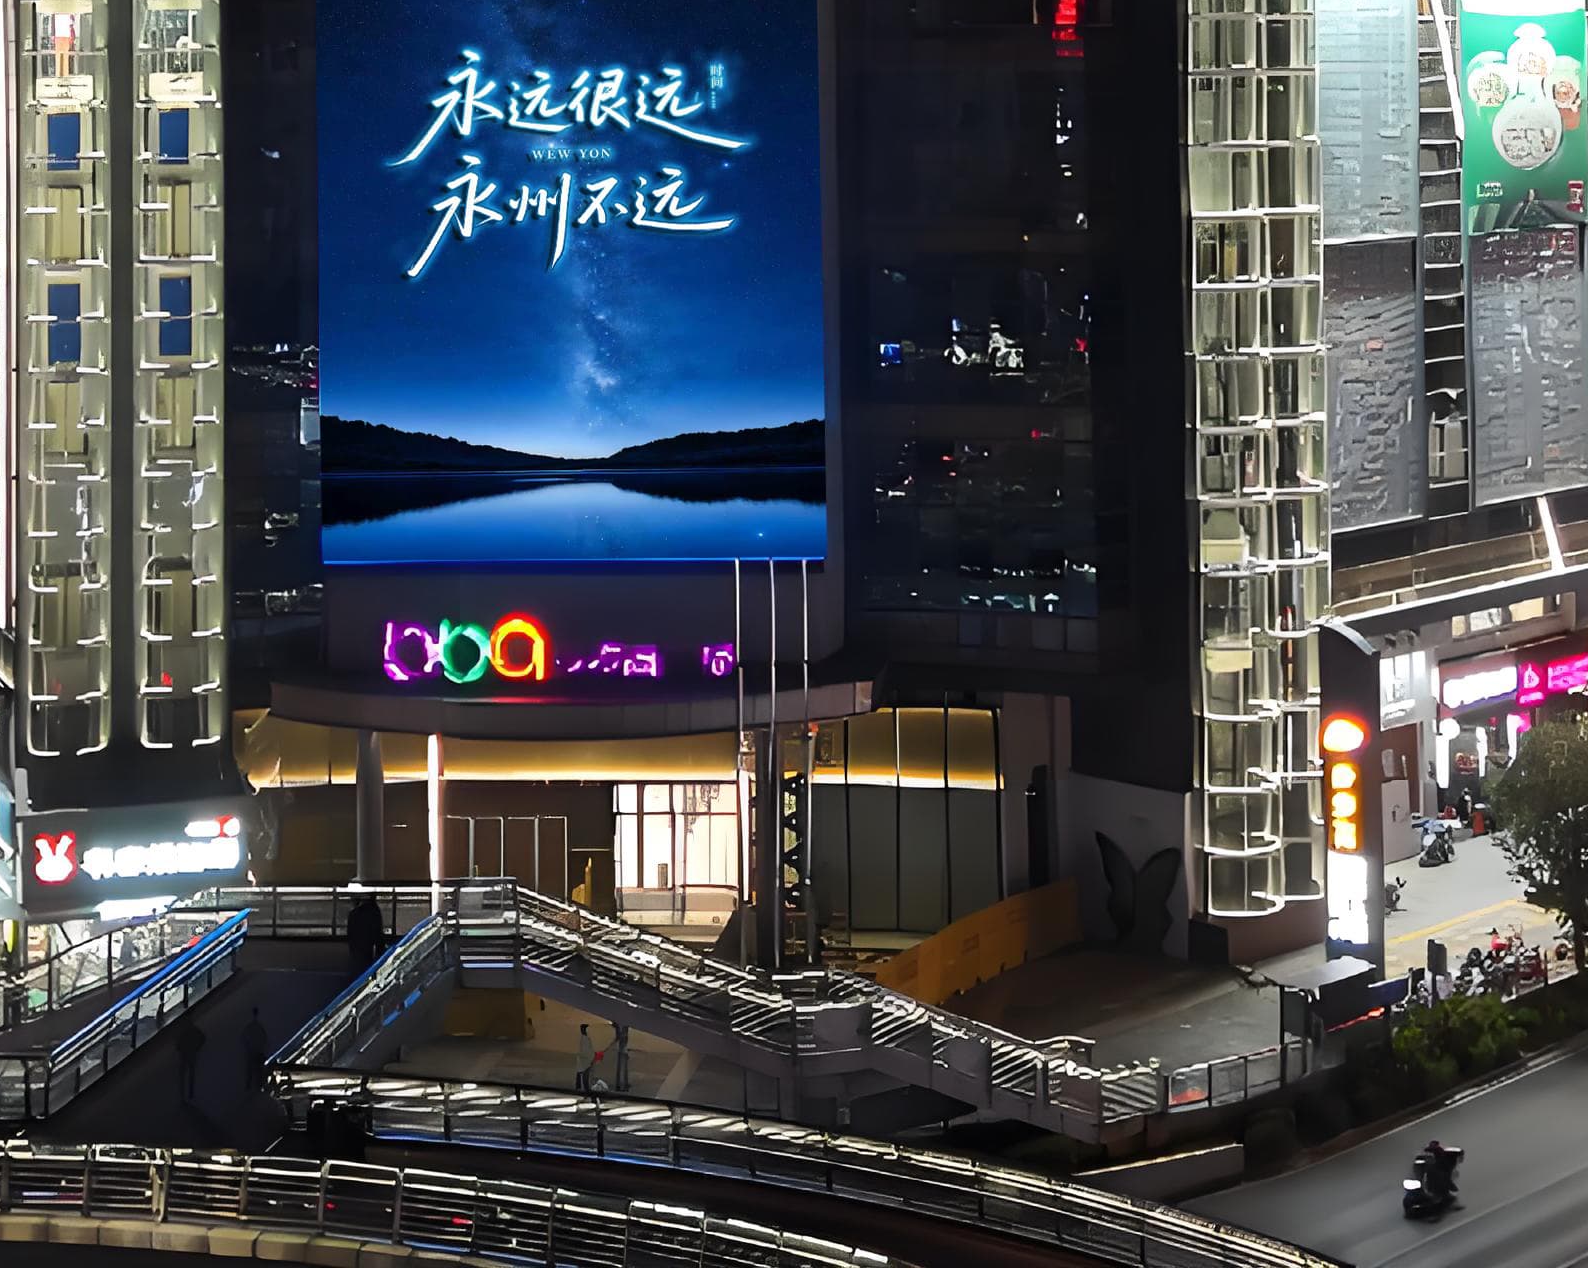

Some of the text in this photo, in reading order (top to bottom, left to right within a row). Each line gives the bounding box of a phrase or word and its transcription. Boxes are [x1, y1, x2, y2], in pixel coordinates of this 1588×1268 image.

[387, 50, 750, 166] 永远很远
[408, 155, 735, 278] 永州不远
